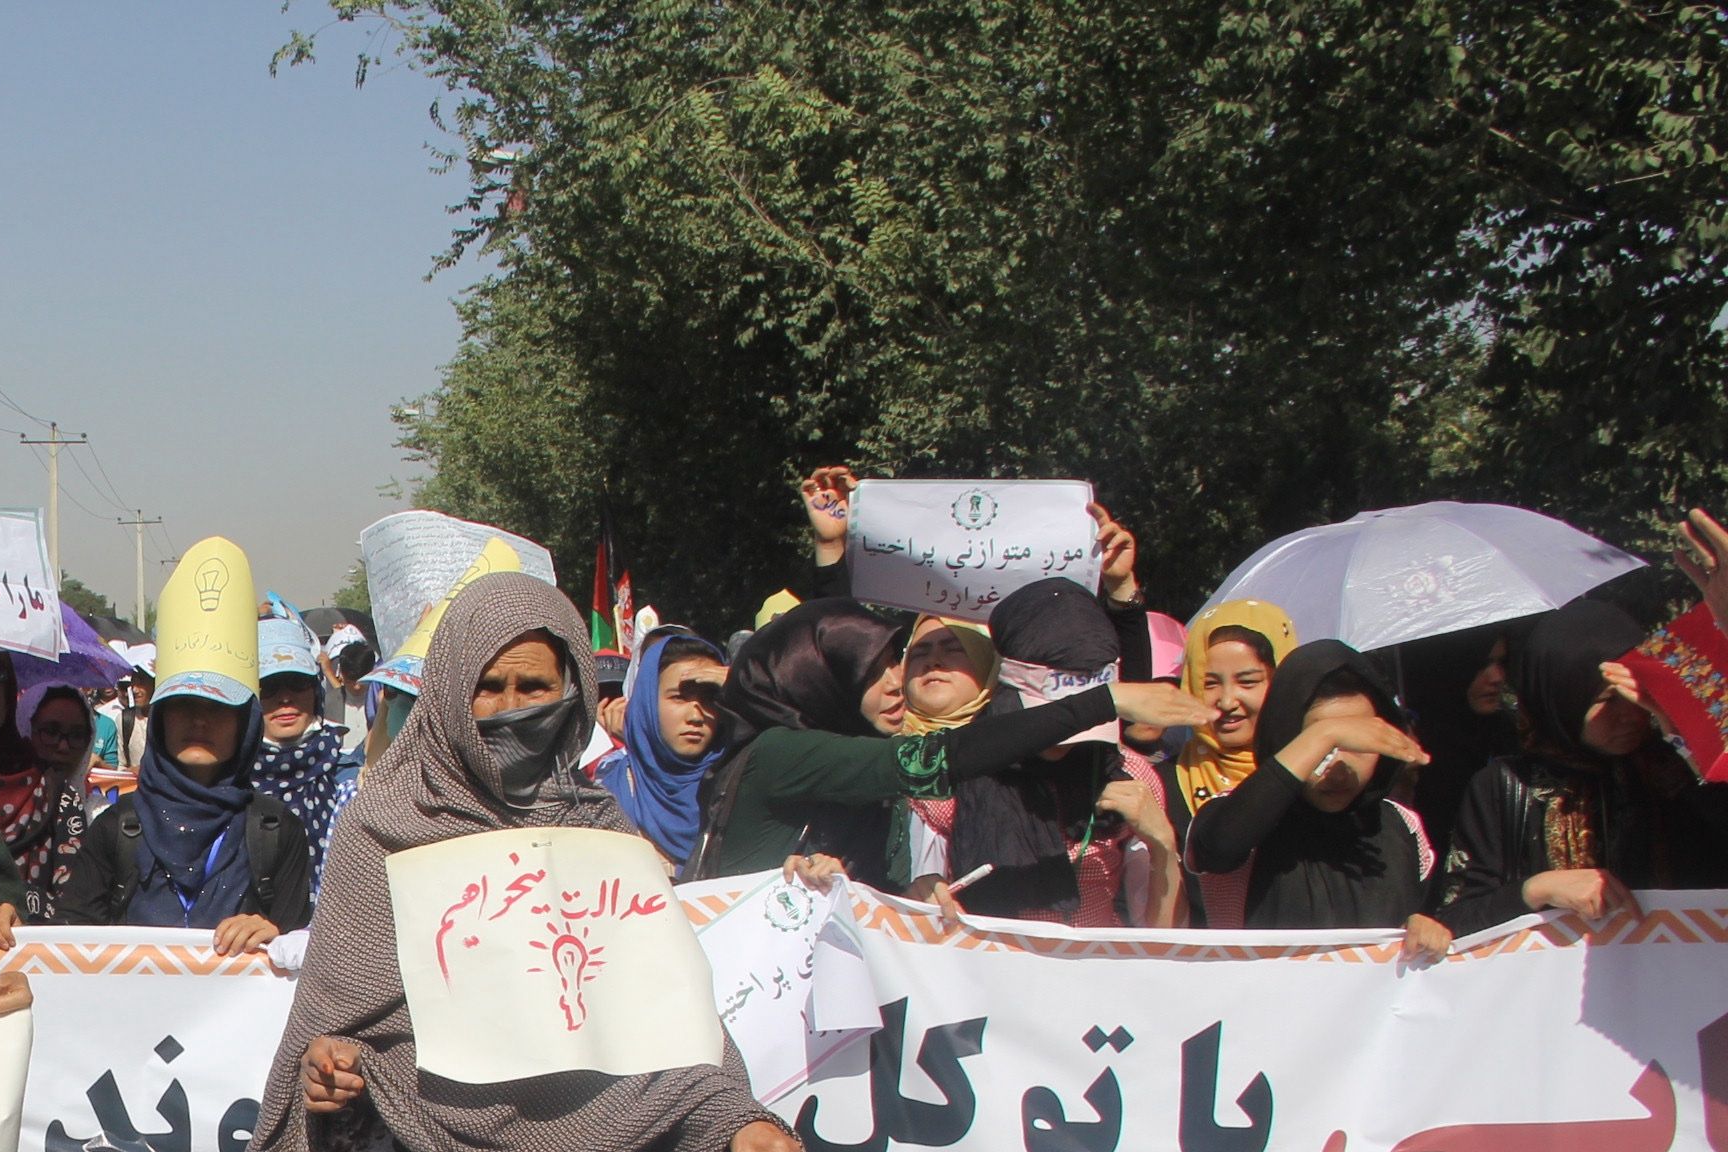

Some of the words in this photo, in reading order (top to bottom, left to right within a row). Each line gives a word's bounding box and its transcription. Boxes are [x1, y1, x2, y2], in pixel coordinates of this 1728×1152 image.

[2, 571, 28, 619] را
[22, 573, 45, 611] ما
[560, 877, 667, 920] عدالت
